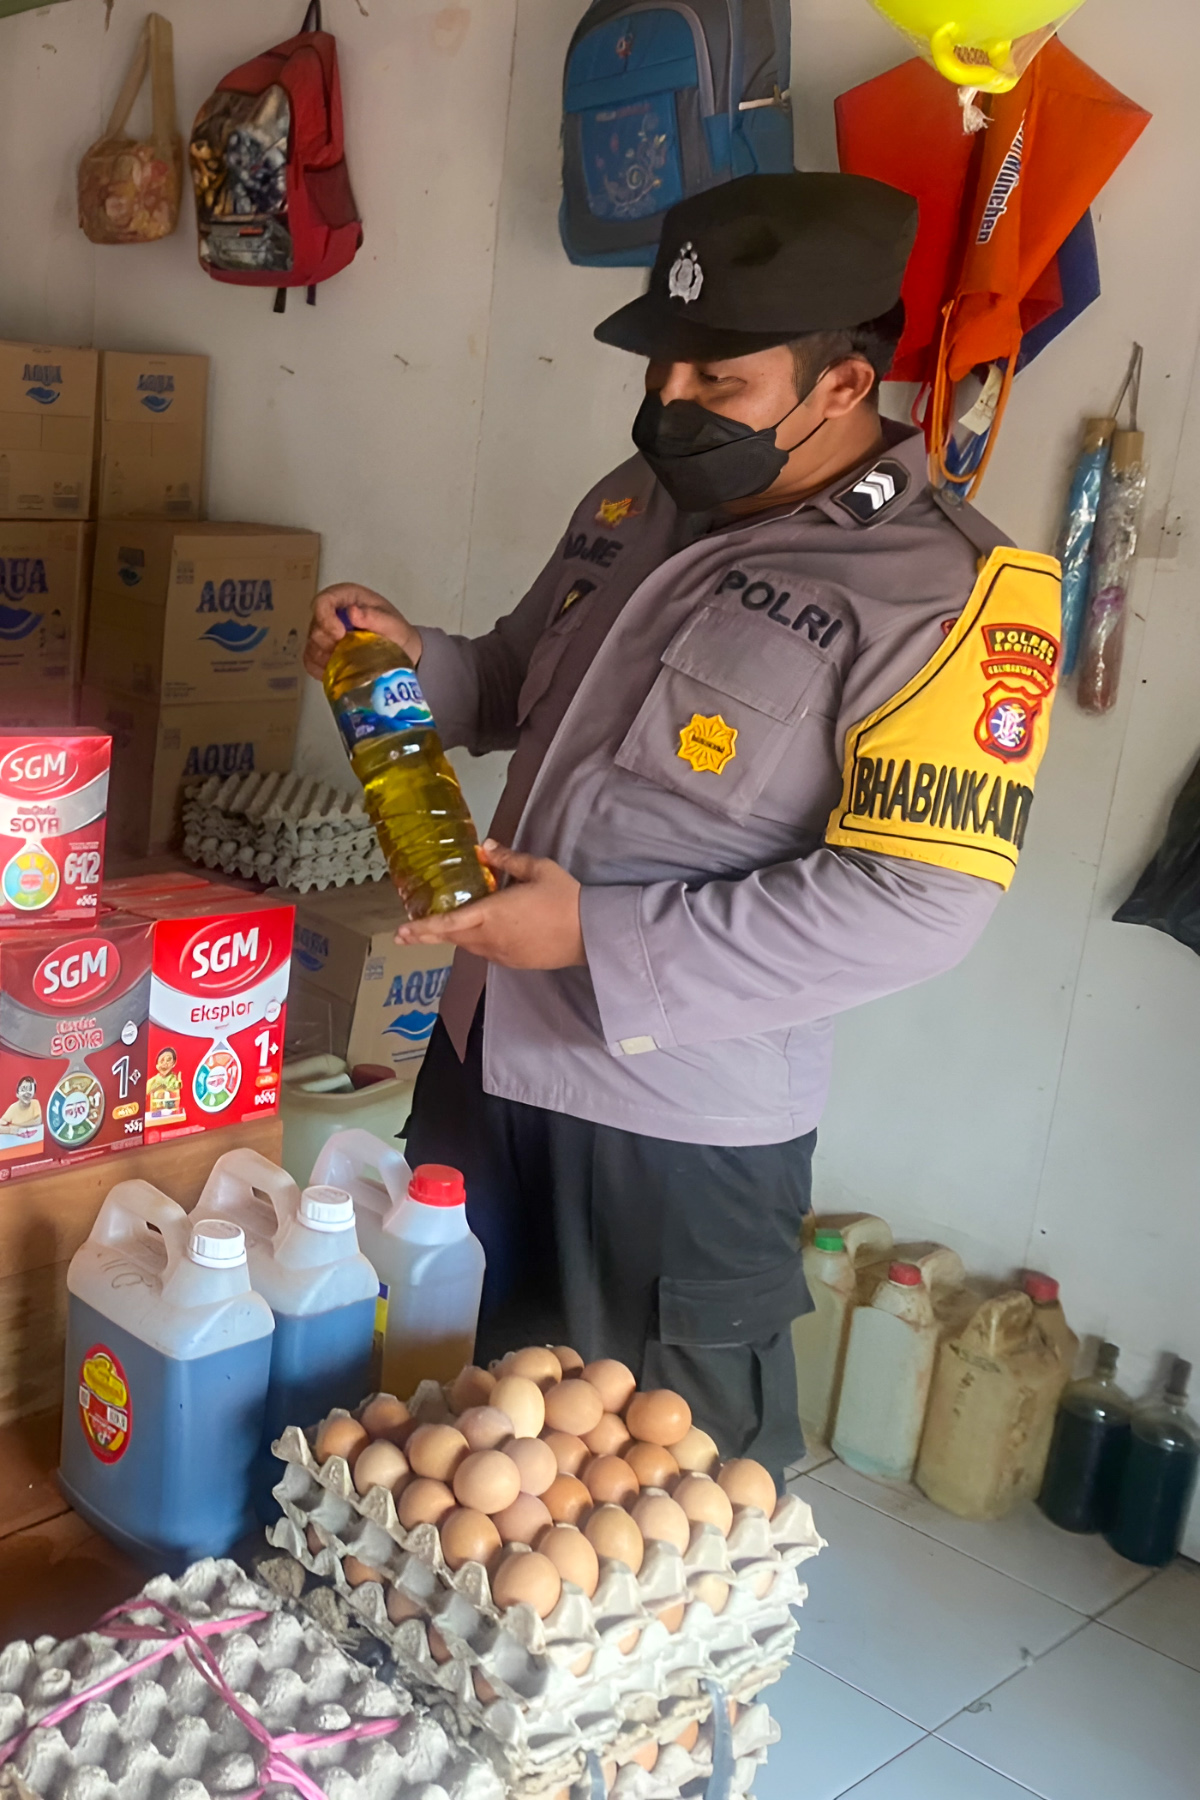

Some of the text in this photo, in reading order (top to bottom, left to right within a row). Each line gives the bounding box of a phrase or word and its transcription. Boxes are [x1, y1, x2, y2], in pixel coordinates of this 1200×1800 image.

[197, 578, 275, 618] AQUA
[714, 570, 843, 648] POLRI
[8, 751, 67, 782] SGM
[181, 742, 255, 779] AQUA
[10, 817, 60, 834] SOYA
[42, 945, 108, 995] SGM
[190, 927, 260, 980] SGM
[381, 964, 454, 1008] AQU
[190, 1000, 255, 1023] Eksplor
